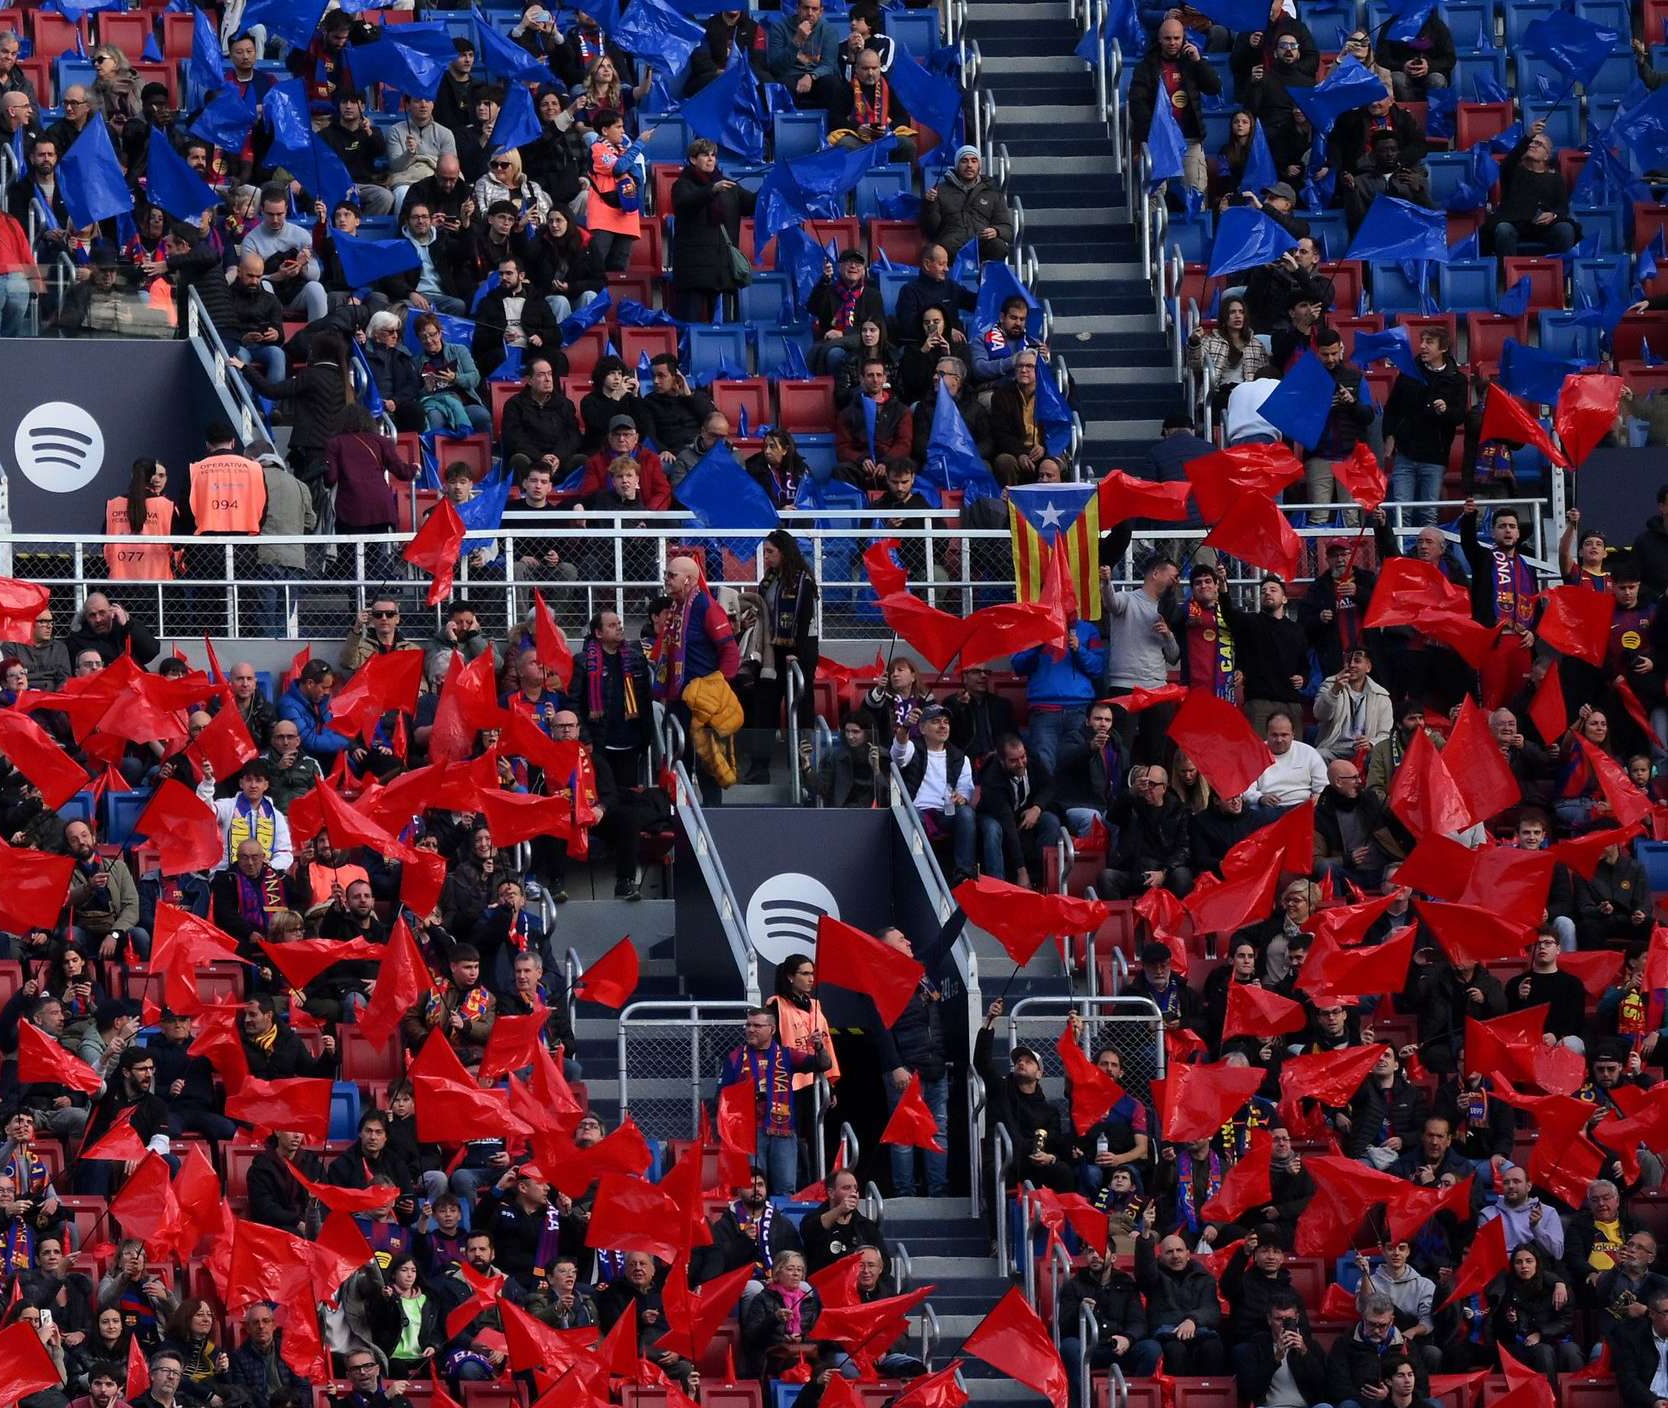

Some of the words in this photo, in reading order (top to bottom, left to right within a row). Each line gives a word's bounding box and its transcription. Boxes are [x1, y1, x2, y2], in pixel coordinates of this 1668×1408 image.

[200, 462, 248, 471] OPERATIVA
[211, 499, 239, 511] 094
[117, 551, 144, 561] 077
